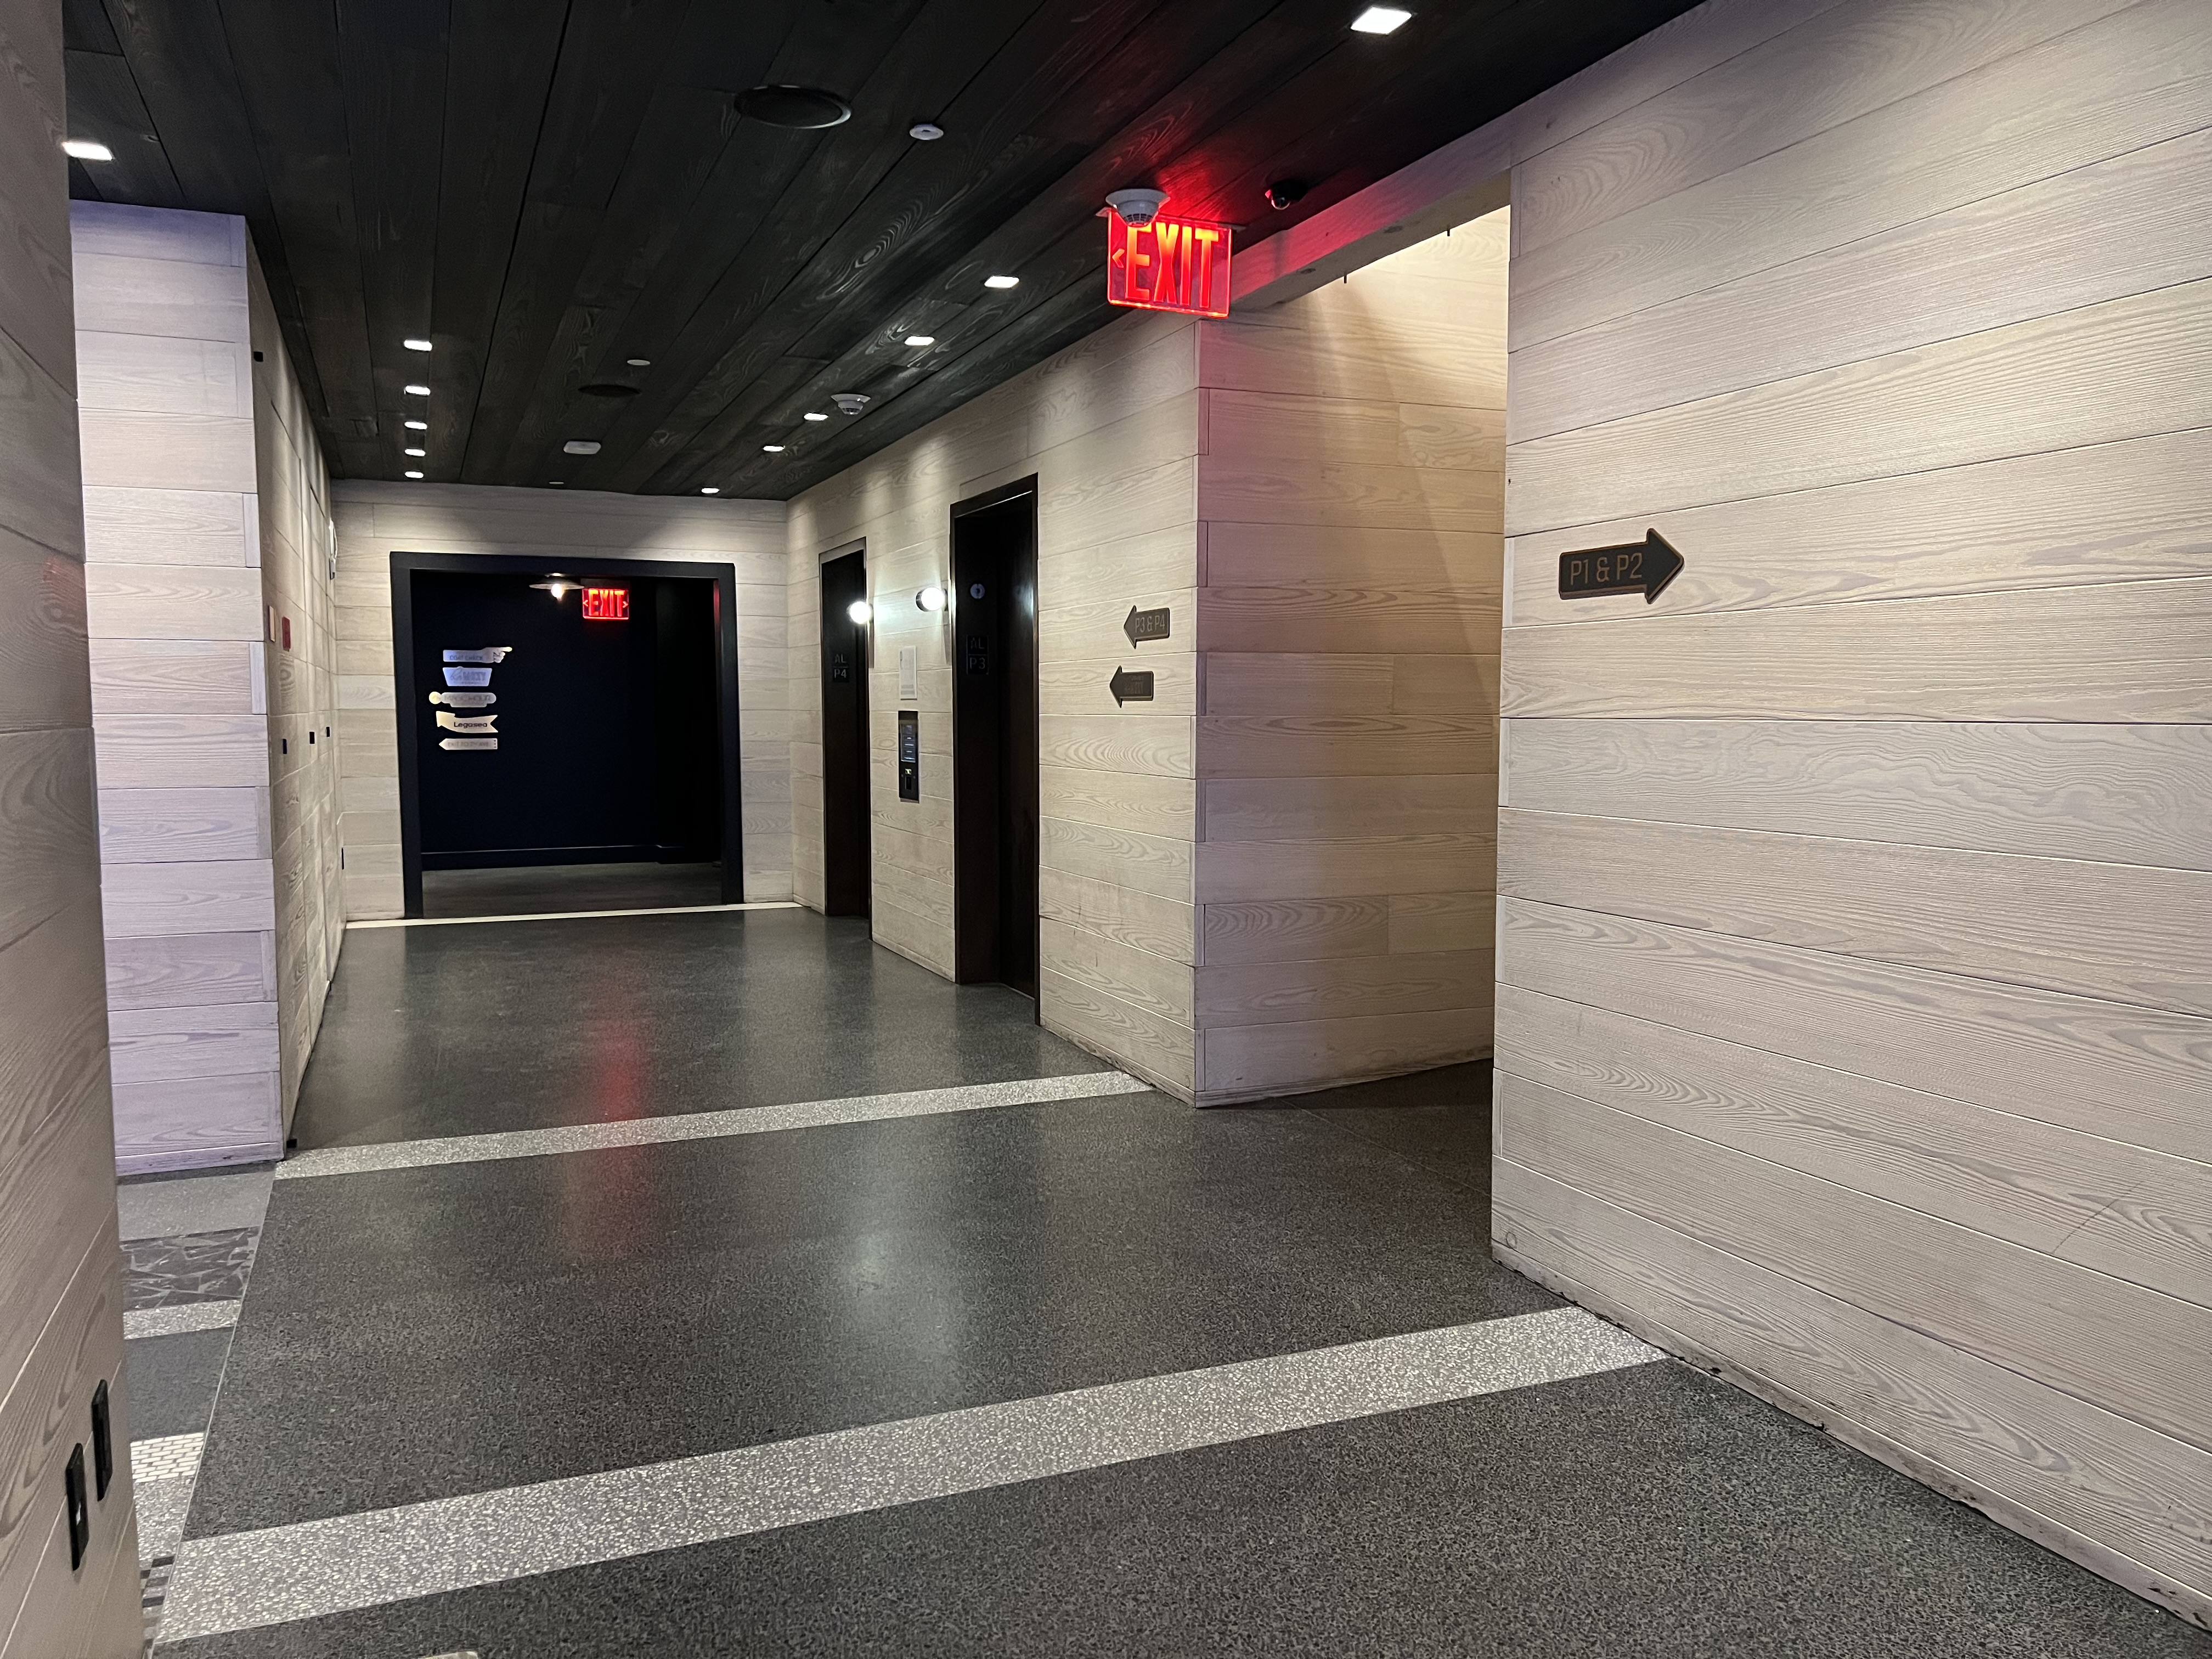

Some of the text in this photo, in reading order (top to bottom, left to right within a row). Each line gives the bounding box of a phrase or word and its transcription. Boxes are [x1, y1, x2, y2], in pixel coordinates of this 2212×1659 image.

[1125, 221, 1219, 308] EXIT
[1570, 552, 1643, 586] P1 & P2
[588, 589, 624, 617] EXIT
[1135, 614, 1165, 633] P3 & P4
[834, 669, 847, 679] P4
[969, 656, 986, 669] P3
